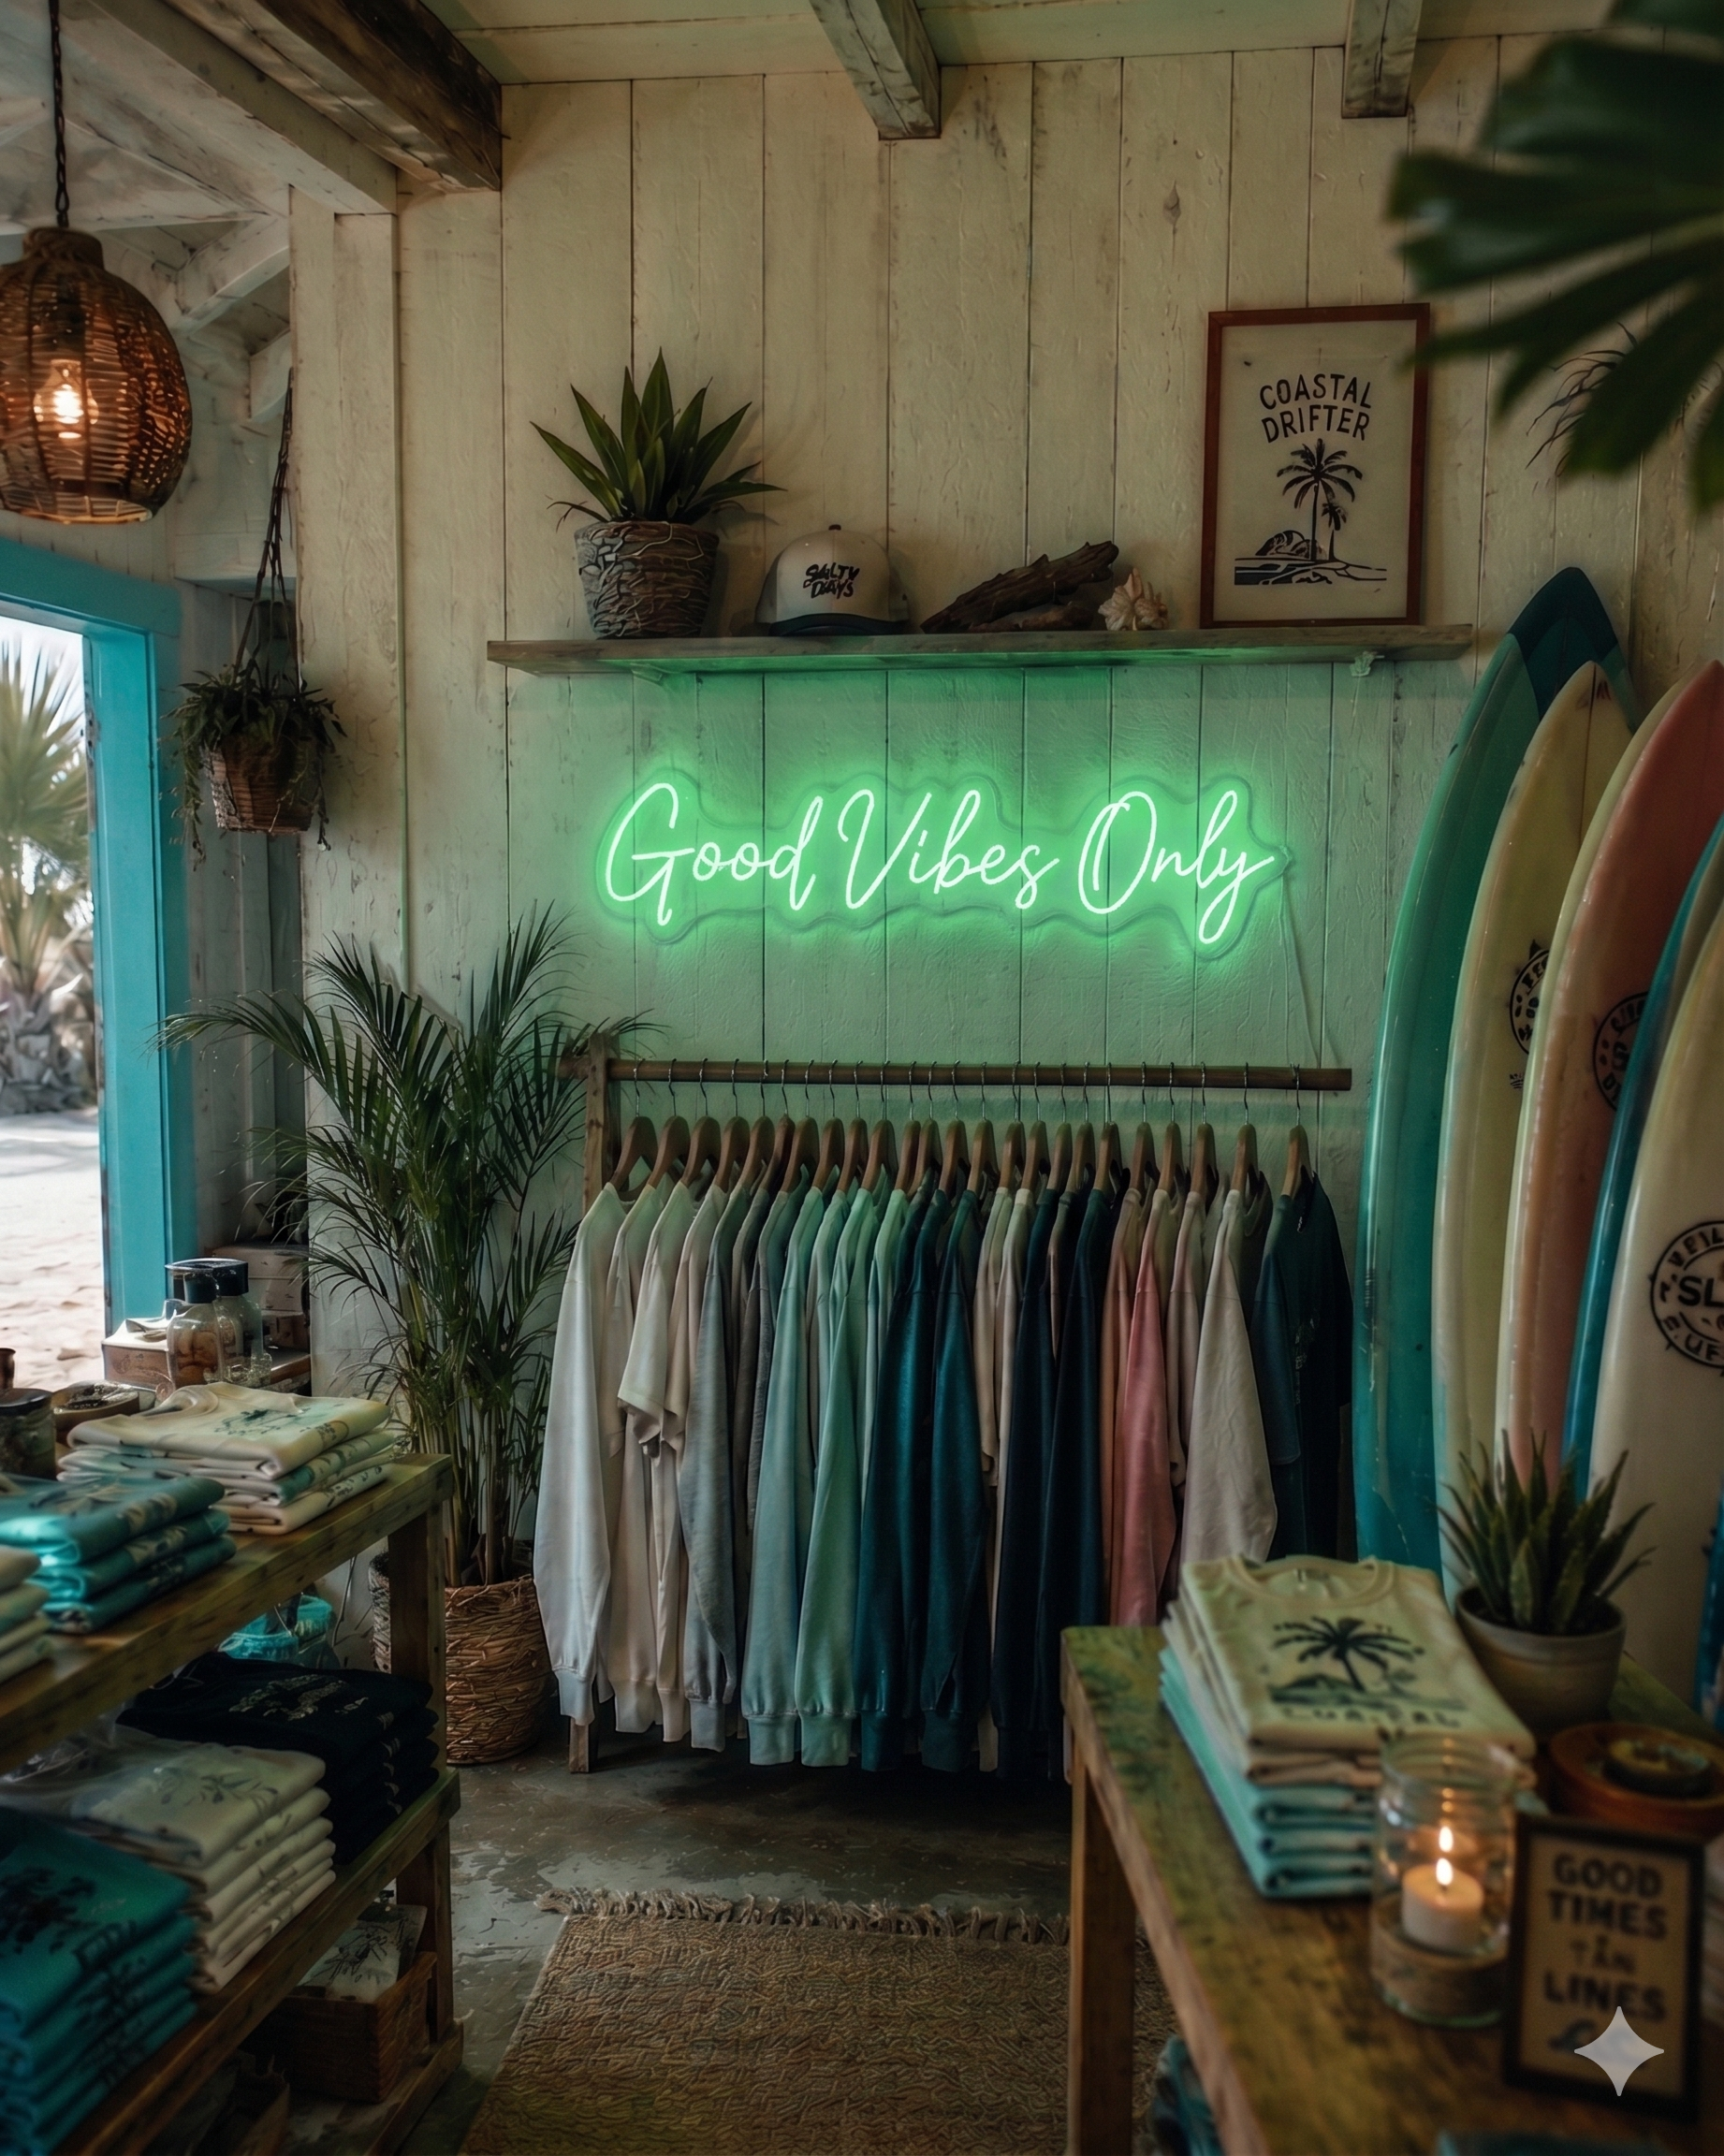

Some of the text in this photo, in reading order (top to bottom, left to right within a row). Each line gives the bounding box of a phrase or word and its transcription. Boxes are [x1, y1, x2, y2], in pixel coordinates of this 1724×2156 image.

[1259, 373, 1372, 410] COASTAL
[1261, 404, 1371, 444] DRIFTER
[805, 562, 860, 582] SALTY
[811, 579, 855, 599] DAYS
[605, 782, 1276, 944] Good Vibes Only
[1553, 1852, 1663, 1899] GOOD
[1548, 1890, 1668, 1941] TIMES
[1544, 1970, 1668, 2022] LINES
